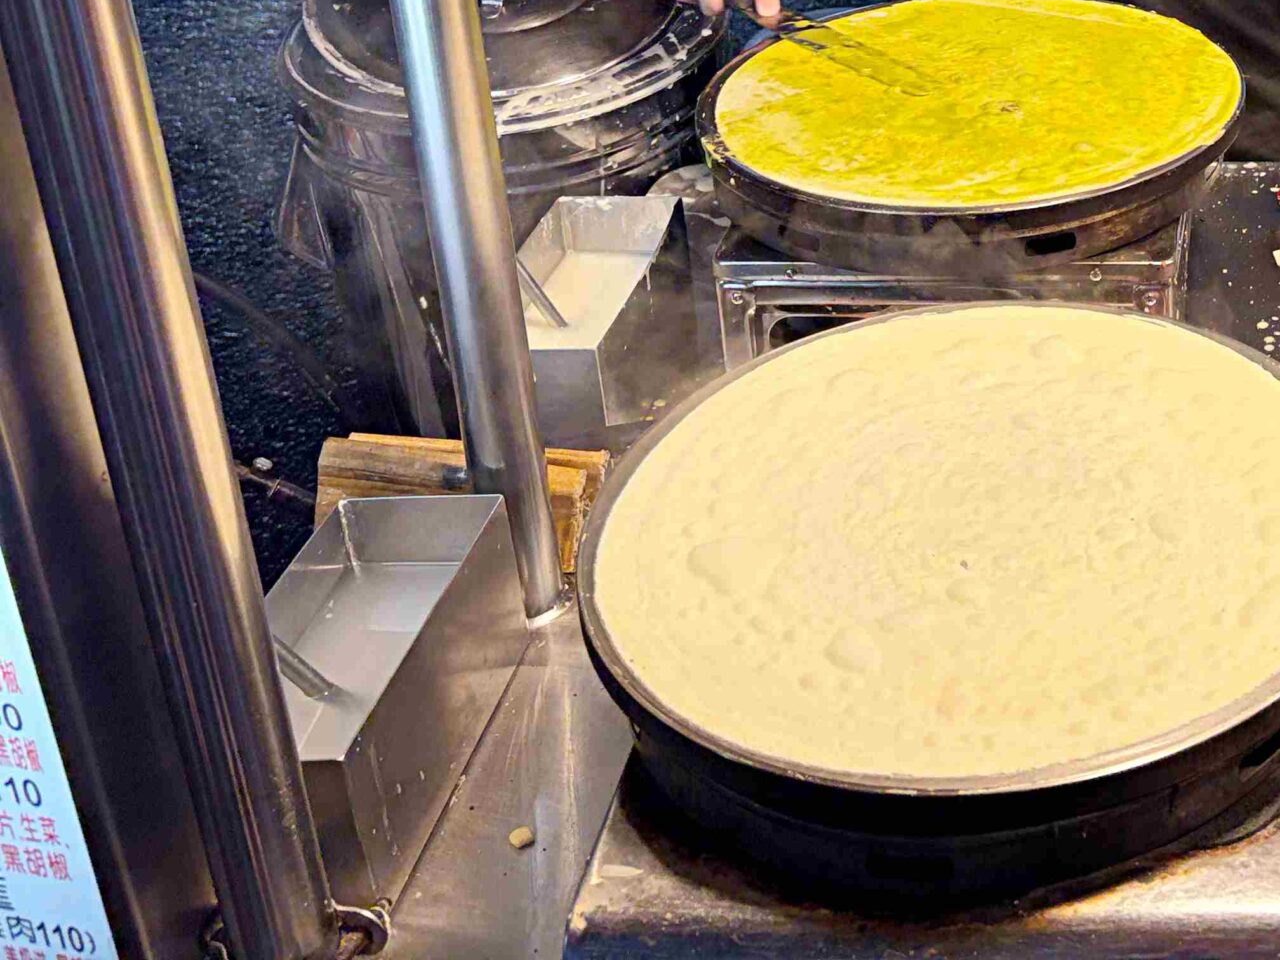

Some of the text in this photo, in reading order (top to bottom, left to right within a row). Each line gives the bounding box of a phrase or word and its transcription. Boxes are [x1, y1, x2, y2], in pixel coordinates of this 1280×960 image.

[1, 843, 73, 882] 黑胡椒
[0, 915, 97, 955] 肉110)
